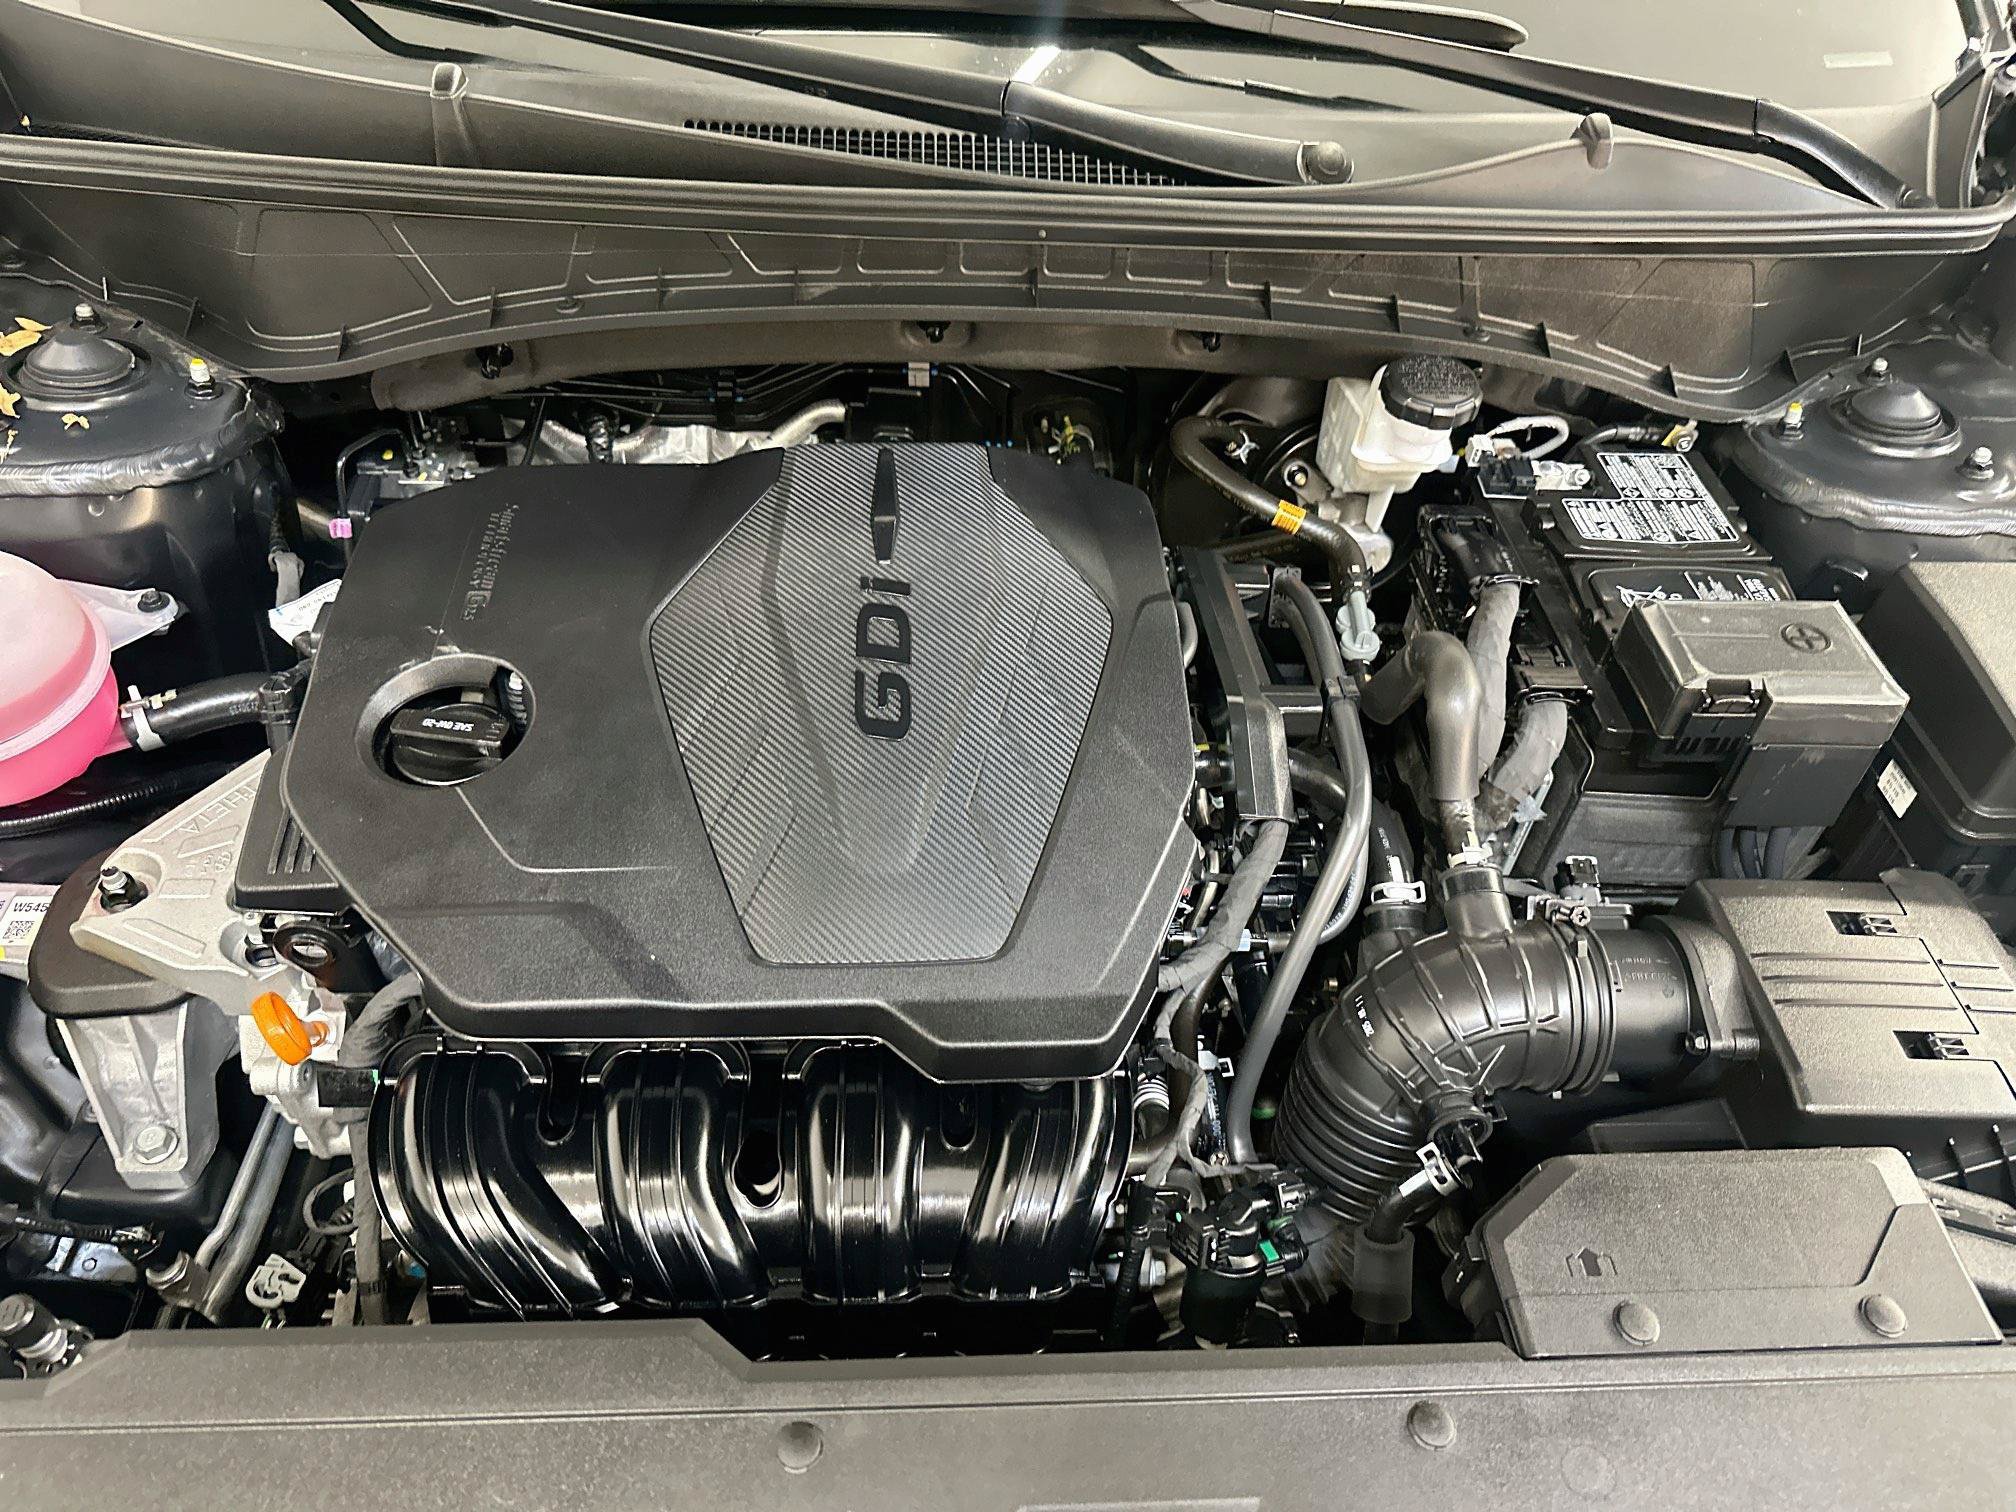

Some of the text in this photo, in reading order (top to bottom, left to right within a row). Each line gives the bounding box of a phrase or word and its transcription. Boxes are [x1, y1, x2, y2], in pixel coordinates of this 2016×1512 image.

[855, 576, 911, 742] GDi
[452, 722, 475, 732] SAE
[179, 785, 257, 834] THETA
[13, 902, 50, 913] W545
